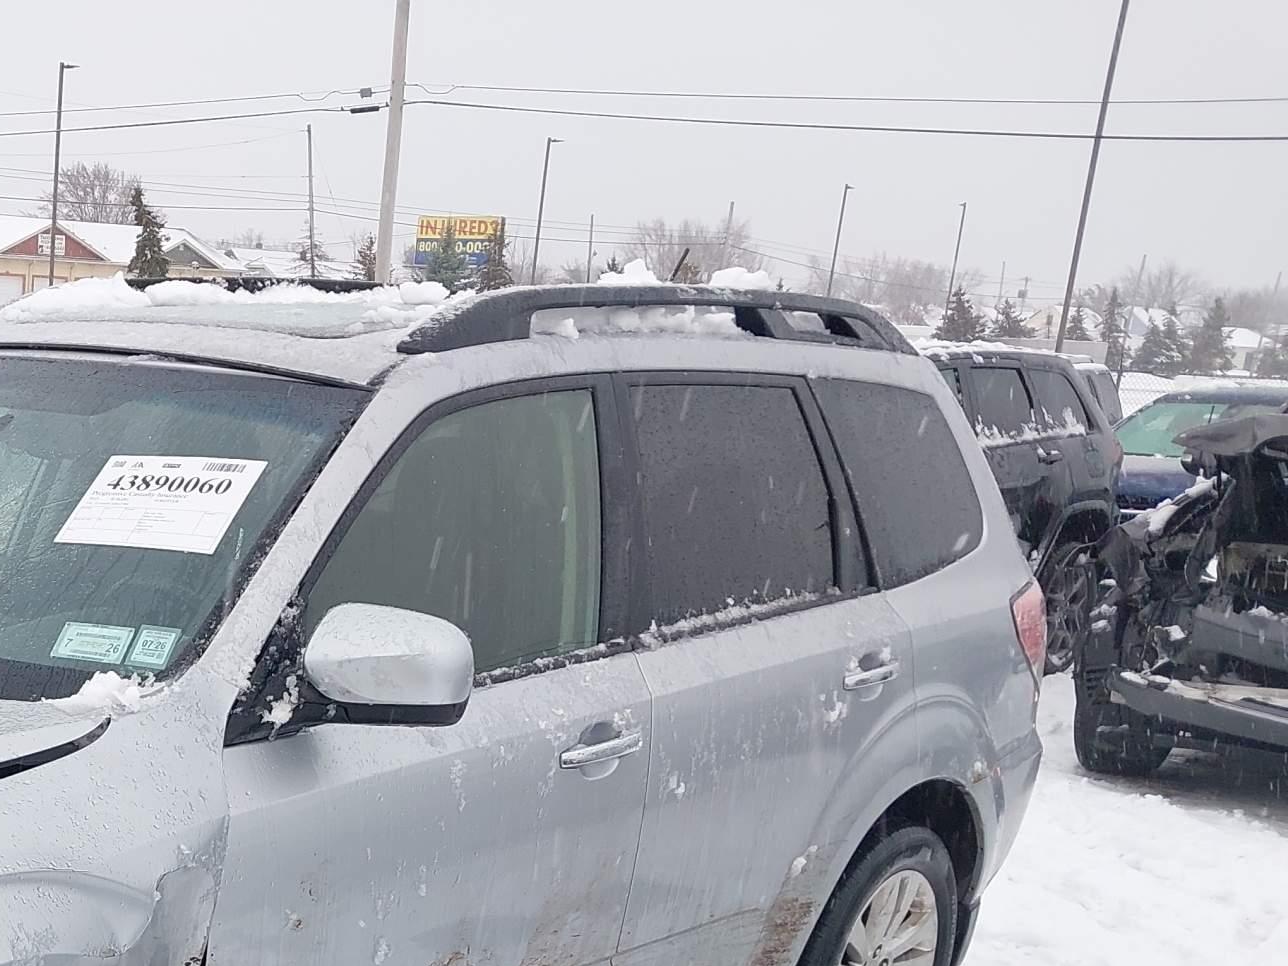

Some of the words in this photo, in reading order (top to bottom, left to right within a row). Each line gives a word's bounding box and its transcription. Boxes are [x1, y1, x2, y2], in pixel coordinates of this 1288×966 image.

[107, 474, 233, 495] 43890060
[64, 638, 73, 647] 7
[105, 643, 120, 654] 26
